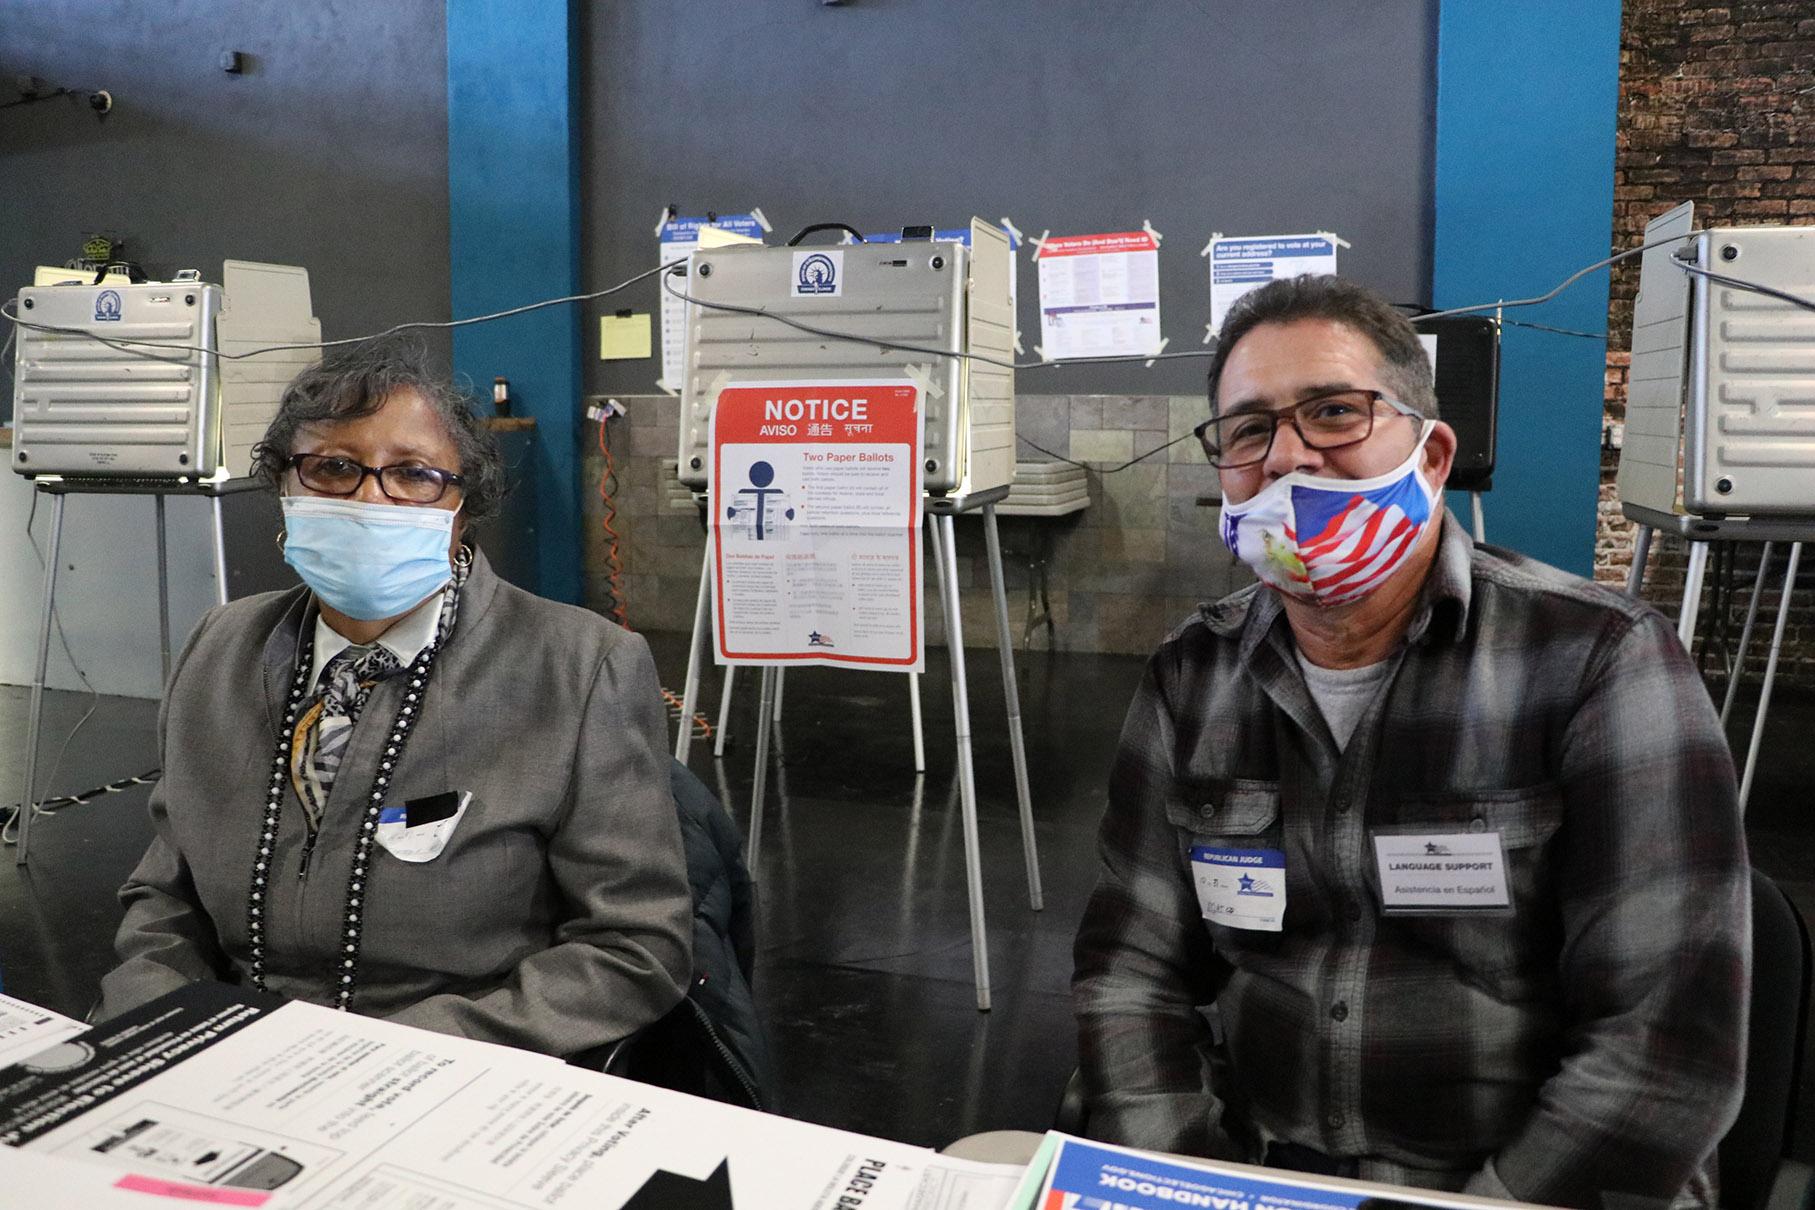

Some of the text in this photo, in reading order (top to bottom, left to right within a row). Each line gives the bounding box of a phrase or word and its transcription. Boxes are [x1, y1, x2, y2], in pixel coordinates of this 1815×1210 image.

[1229, 245, 1241, 253] you
[1243, 242, 1277, 253] registered
[1311, 240, 1327, 249] your
[1242, 249, 1273, 258] address?
[765, 399, 868, 421] NOTICE
[759, 424, 797, 436] AVISO
[807, 424, 833, 437] 通告
[844, 423, 873, 437] सूचना
[803, 453, 894, 464] Two Paper Ballots
[1240, 856, 1263, 864] JUDGE
[1389, 862, 1493, 871] LANGUAGE SUPPORT
[1395, 886, 1440, 894] Asistencia
[1457, 885, 1495, 895] Español
[624, 1107, 651, 1129] After
[846, 1158, 887, 1196] PLACE
[1099, 1172, 1250, 1210] HANDBOOK
